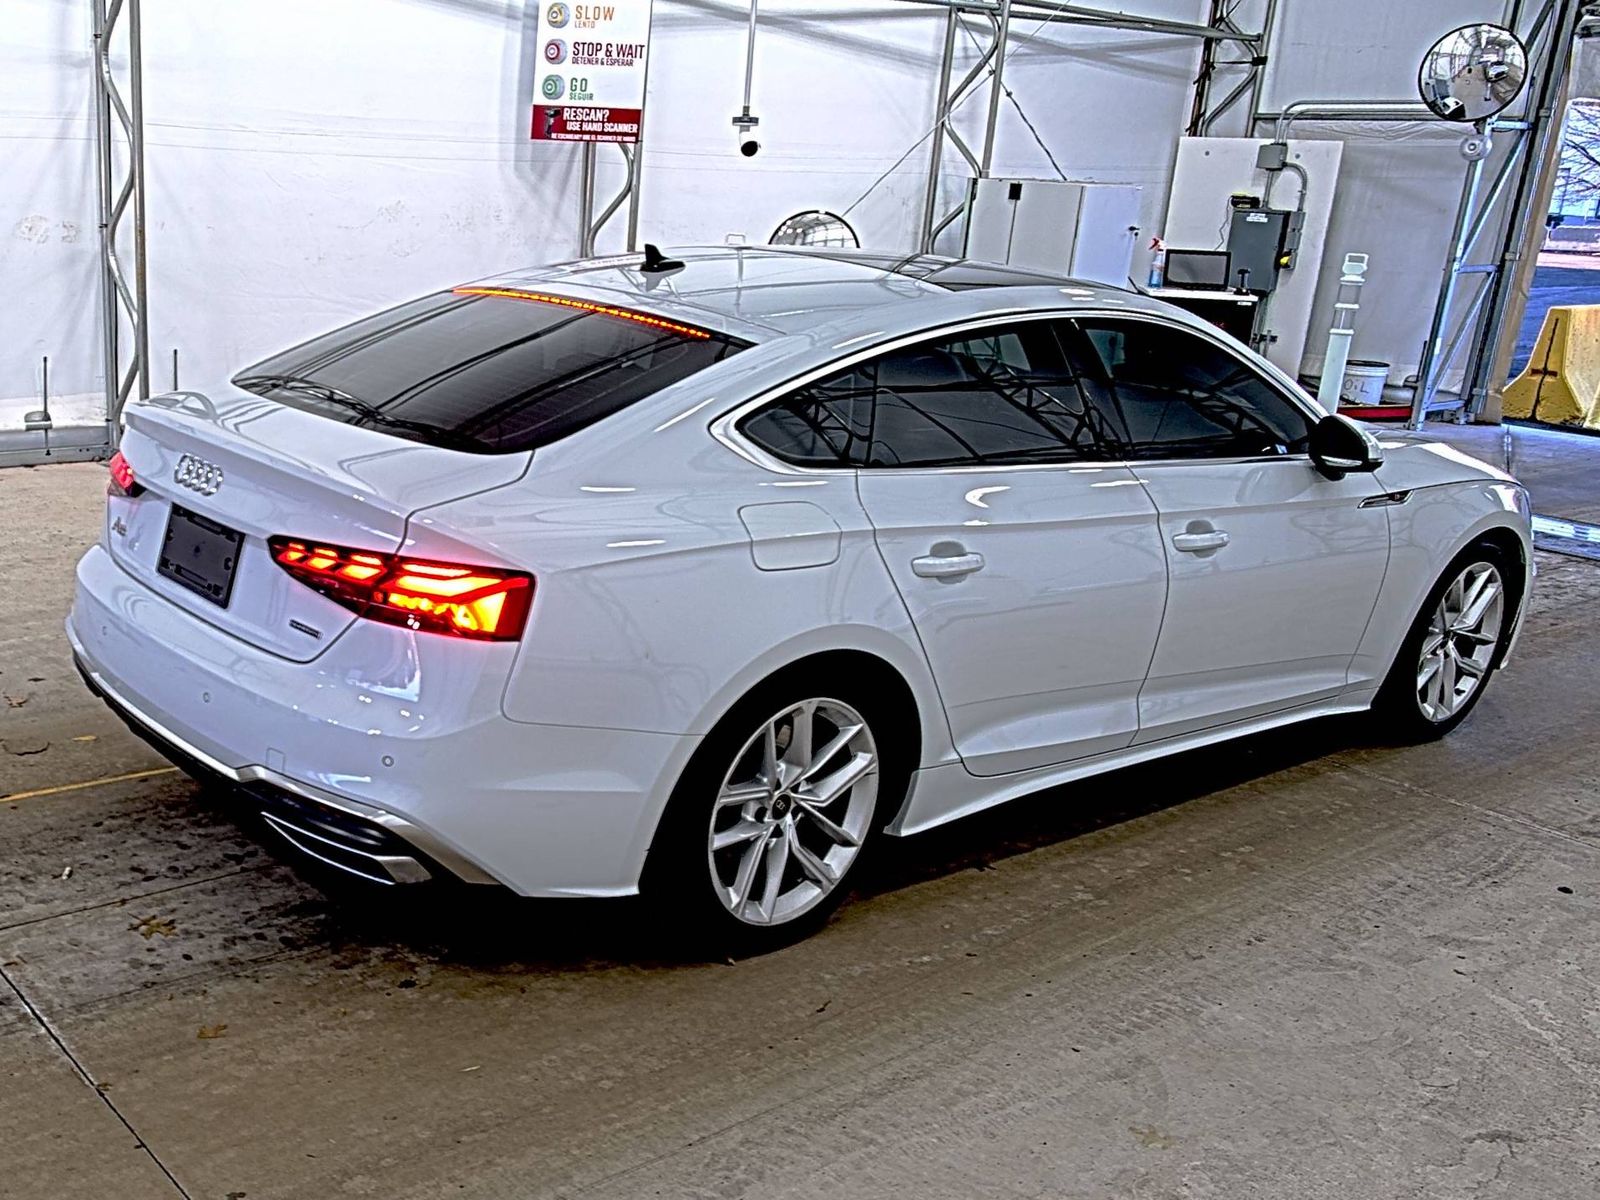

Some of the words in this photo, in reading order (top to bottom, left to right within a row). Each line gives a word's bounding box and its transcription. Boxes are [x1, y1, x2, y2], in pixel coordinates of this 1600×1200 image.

[575, 5, 615, 21] SLOW
[572, 41, 602, 57] STOP
[605, 43, 613, 57] &
[616, 43, 645, 59] WAIT
[572, 57, 599, 65] DETENER
[600, 58, 605, 66] &
[606, 58, 634, 67] ESPERAR
[570, 77, 588, 92] GO
[569, 92, 594, 101] SEGUIR
[563, 107, 610, 122] RESCAN?
[566, 121, 581, 131] USE
[582, 122, 602, 132] HAND
[603, 123, 638, 133] SCANNER
